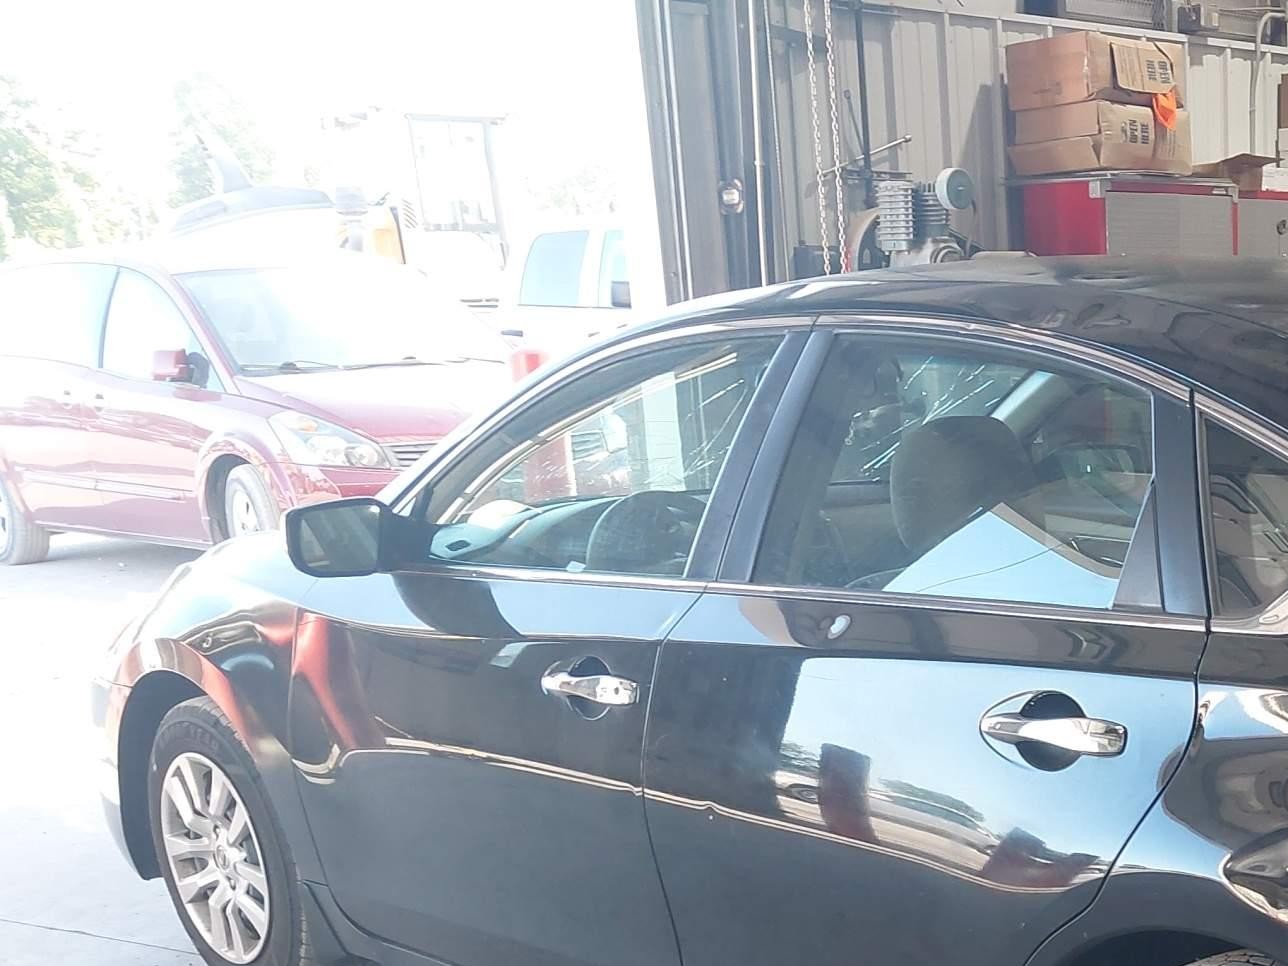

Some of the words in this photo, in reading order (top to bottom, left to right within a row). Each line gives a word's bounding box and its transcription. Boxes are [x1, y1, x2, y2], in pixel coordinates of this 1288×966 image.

[1157, 60, 1171, 84] OPEN
[1128, 119, 1139, 144] OPEN
[1140, 122, 1150, 145] HERE
